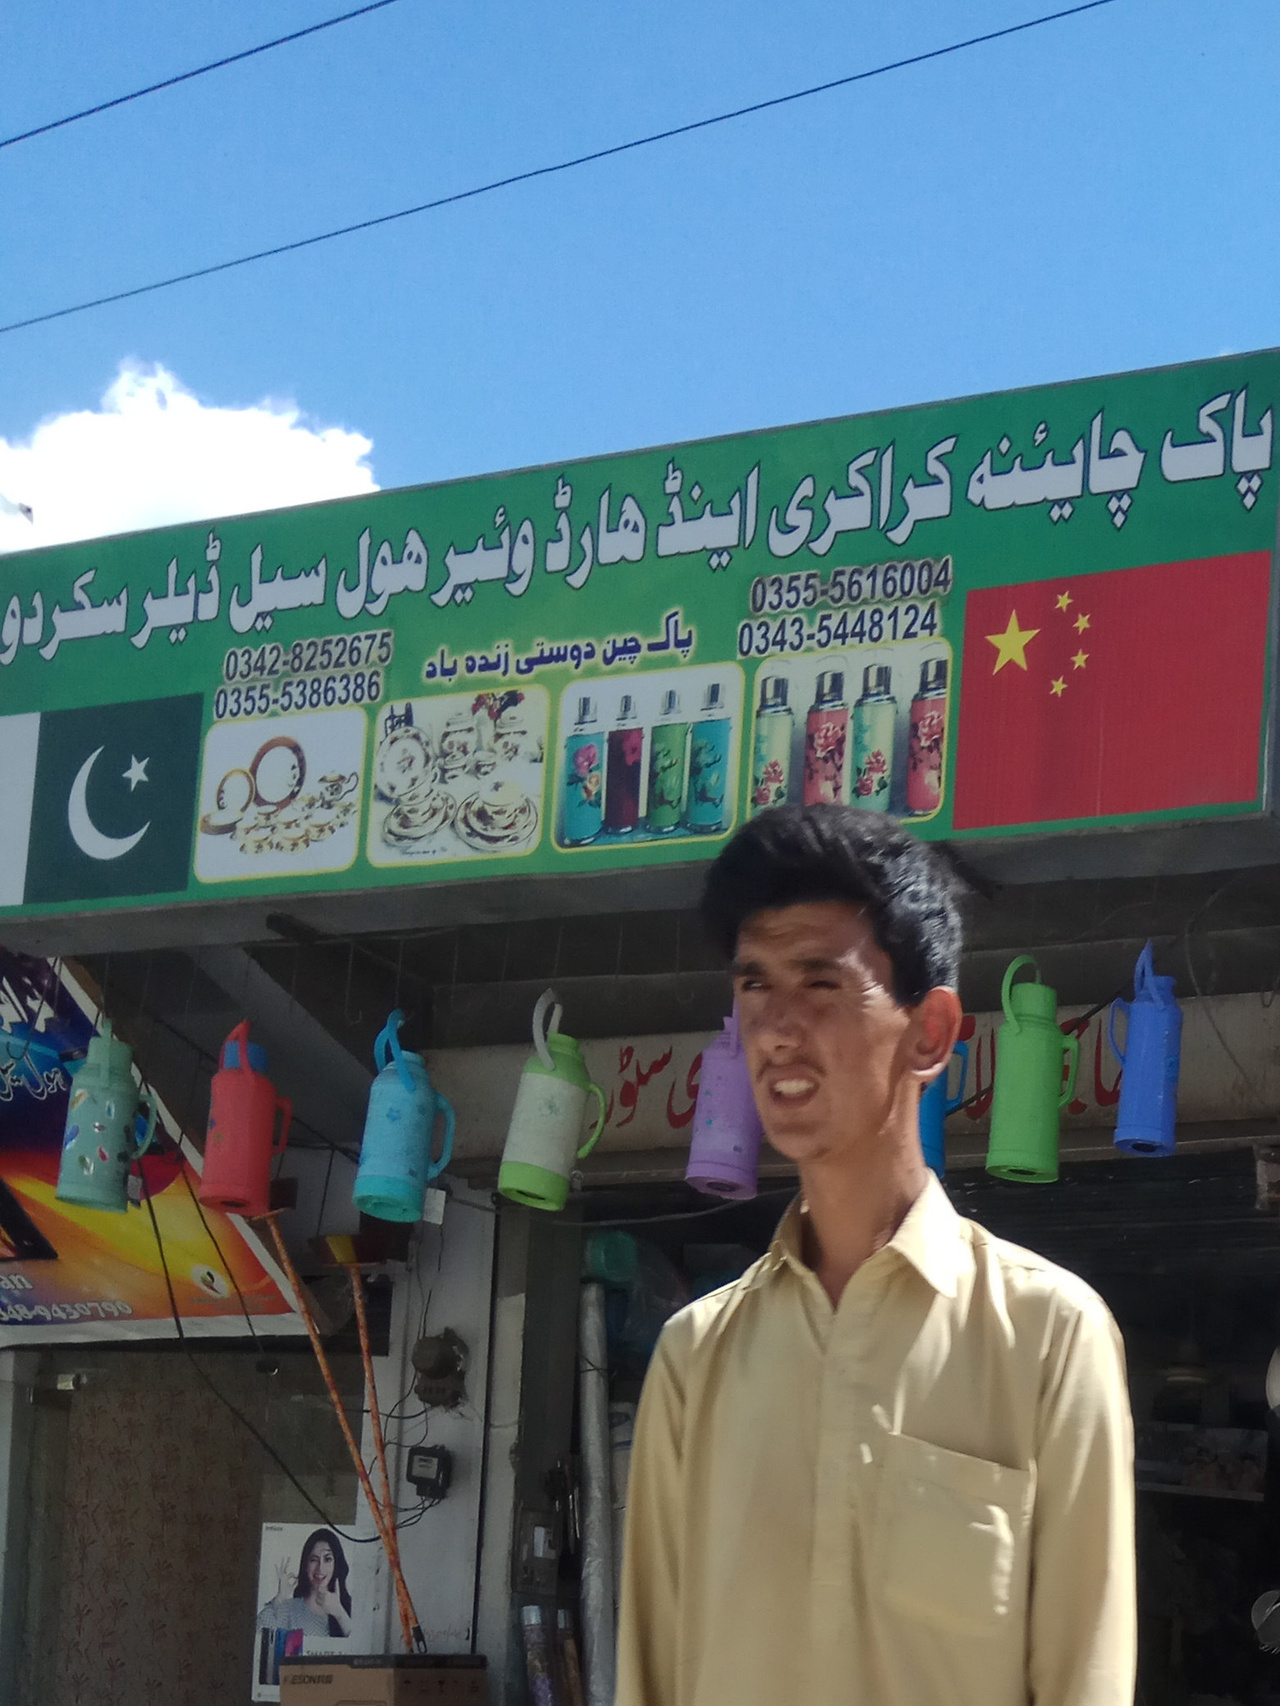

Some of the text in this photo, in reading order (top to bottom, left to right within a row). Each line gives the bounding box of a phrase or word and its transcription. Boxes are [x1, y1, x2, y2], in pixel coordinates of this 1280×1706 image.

[1160, 383, 1274, 512] پاک
[656, 456, 760, 572] اینڈ
[767, 433, 960, 558] کراکری
[129, 528, 222, 650] ڈیلر
[229, 542, 327, 634] سیل
[751, 557, 951, 613] 0355-5616004
[225, 631, 392, 681] 0342-8252675
[602, 635, 642, 667] چین
[647, 610, 694, 658] پاک
[738, 601, 938, 657] 0343-5448124
[425, 648, 459, 682] باد
[515, 641, 597, 676] دوستی
[215, 670, 381, 719] 0355-5386386
